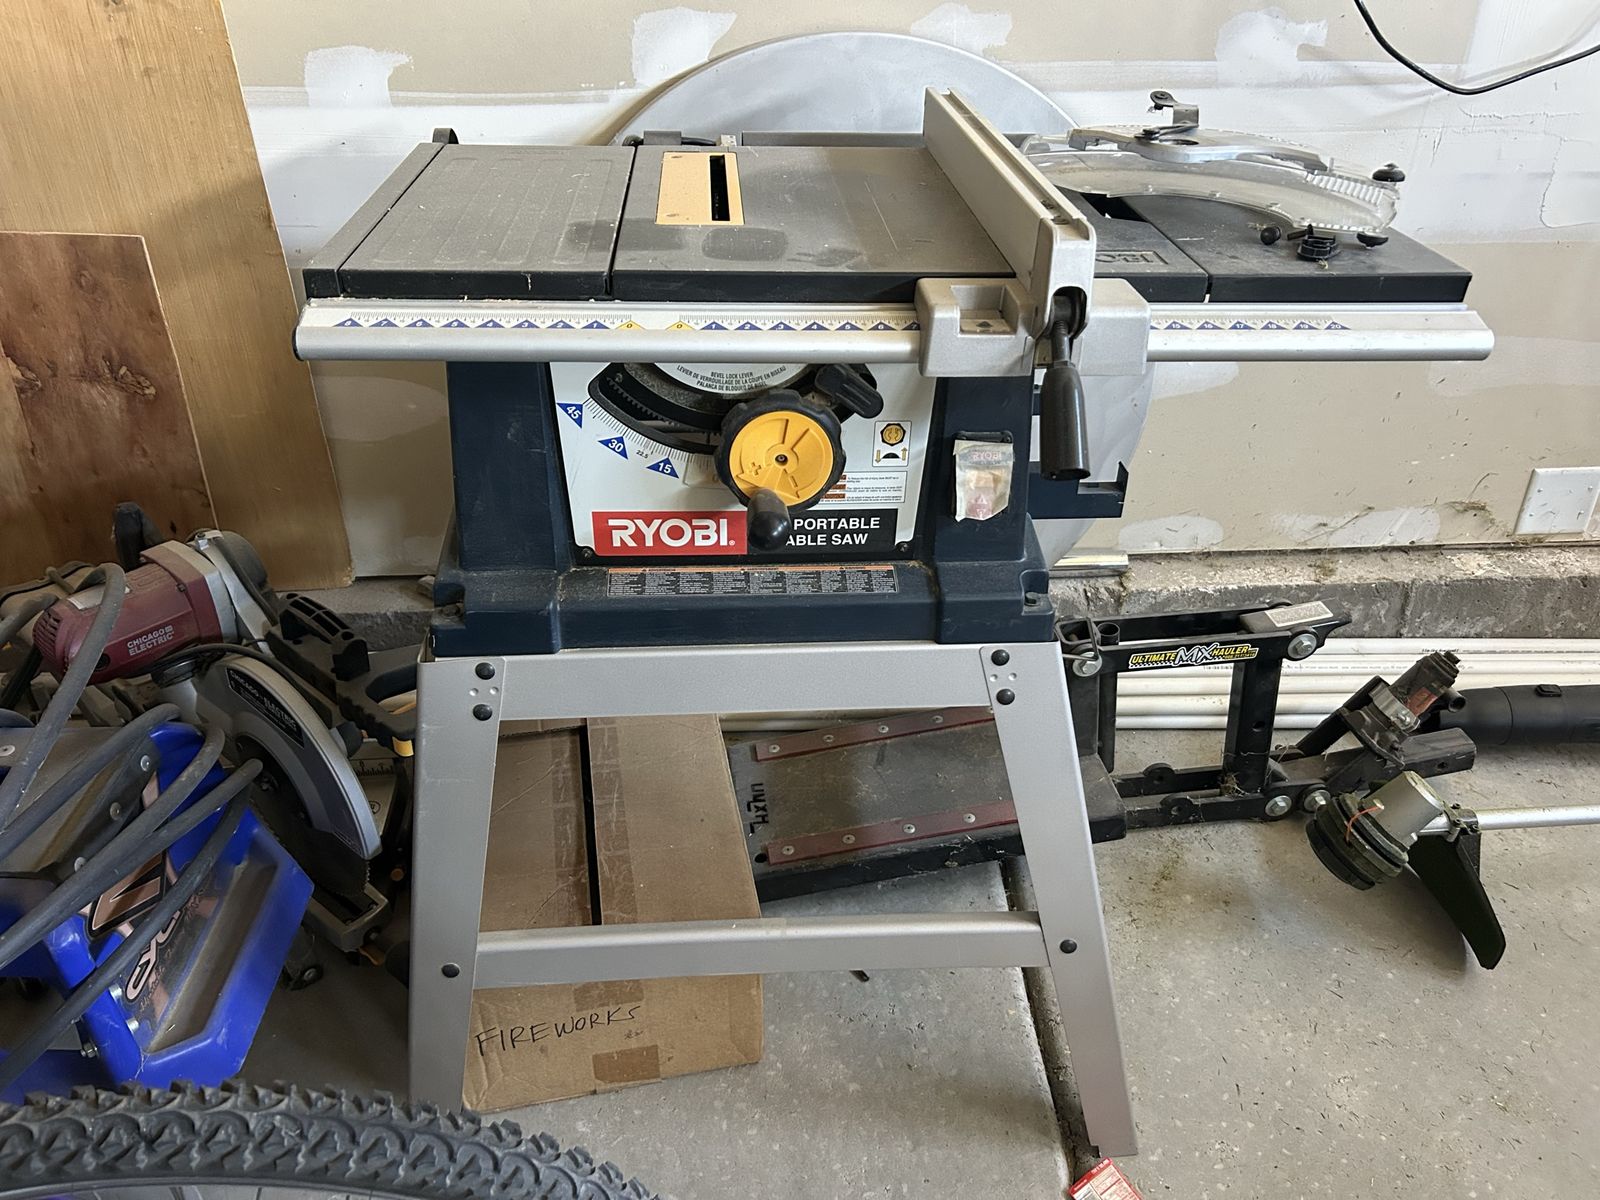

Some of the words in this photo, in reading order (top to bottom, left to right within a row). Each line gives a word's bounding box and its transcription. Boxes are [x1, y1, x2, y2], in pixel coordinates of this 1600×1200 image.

[677, 365, 693, 377] LEVIER
[748, 375, 764, 384] COUPE
[771, 365, 787, 377] BISEAU
[696, 380, 718, 391] PALANCA
[566, 404, 581, 419] 45
[608, 439, 624, 453] 30
[636, 449, 649, 459] 22.5
[658, 462, 672, 474] 15
[793, 517, 880, 530] PORTABLE
[607, 518, 729, 547] RYOBI
[786, 534, 827, 546] ABLE
[830, 533, 869, 546] SAW
[127, 628, 166, 649] CHICAGO
[128, 633, 173, 656] ELECTRIC
[1131, 652, 1177, 663] ULTIMATE
[1175, 643, 1219, 665] MX
[1211, 645, 1249, 656] HAULER
[474, 1005, 641, 1057] FIREWORKS
